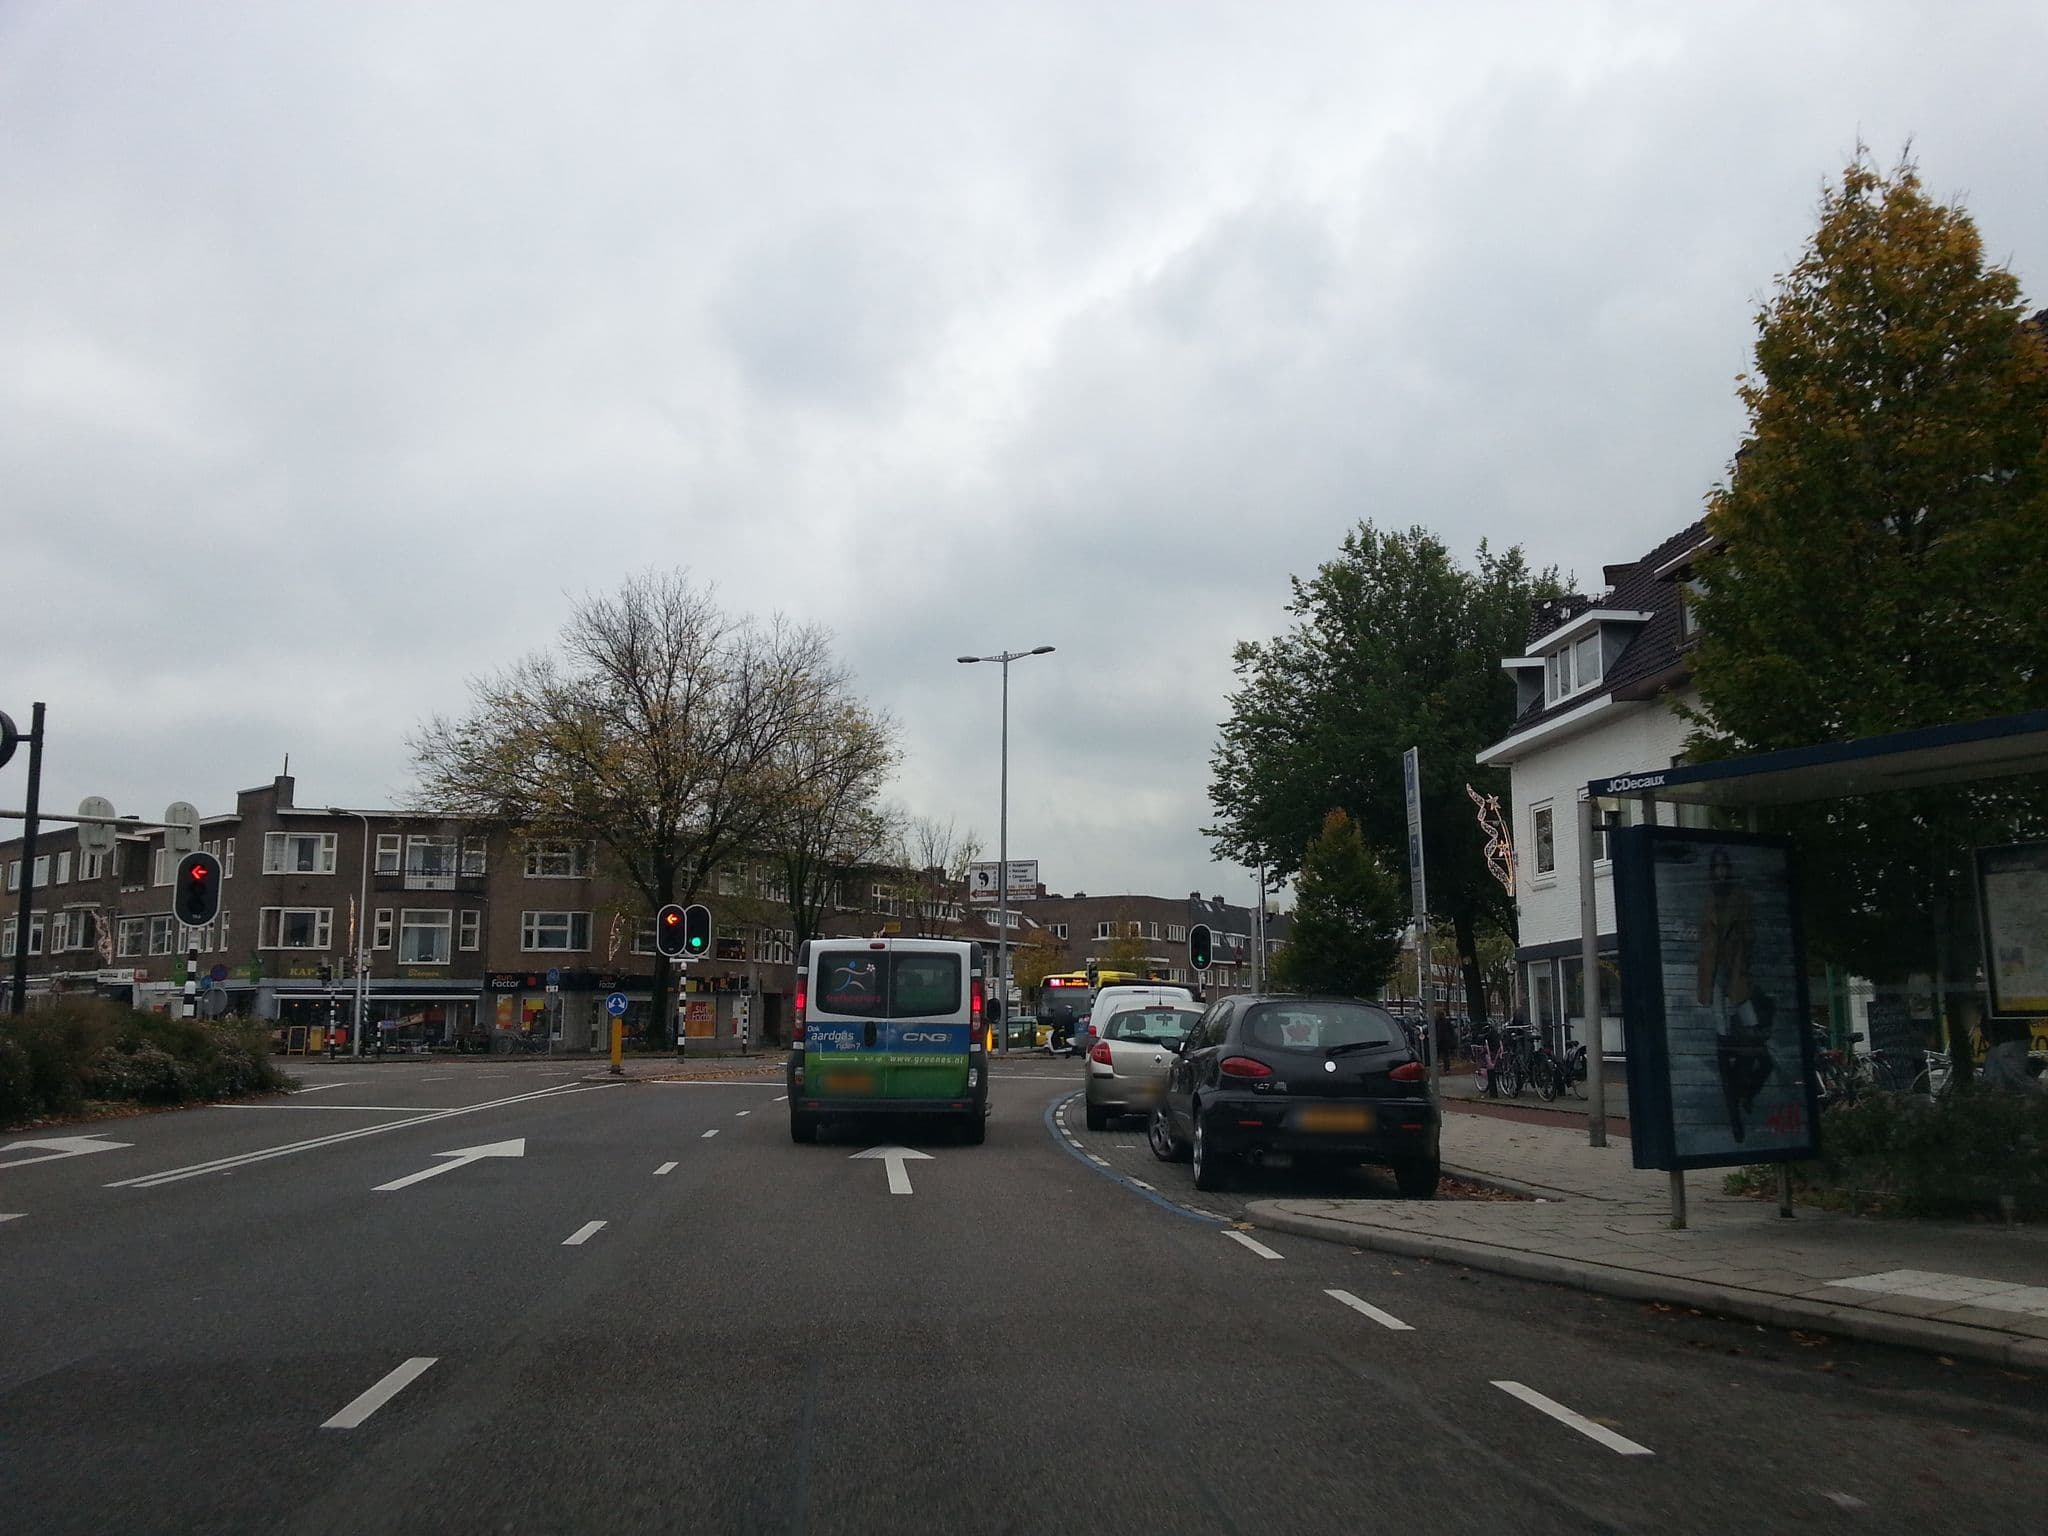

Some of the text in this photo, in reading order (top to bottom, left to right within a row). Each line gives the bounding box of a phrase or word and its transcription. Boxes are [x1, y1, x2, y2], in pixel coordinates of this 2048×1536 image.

[1607, 775, 1665, 792] JCDecaux
[811, 1030, 855, 1043] aardgas
[903, 1033, 947, 1042] CNG
